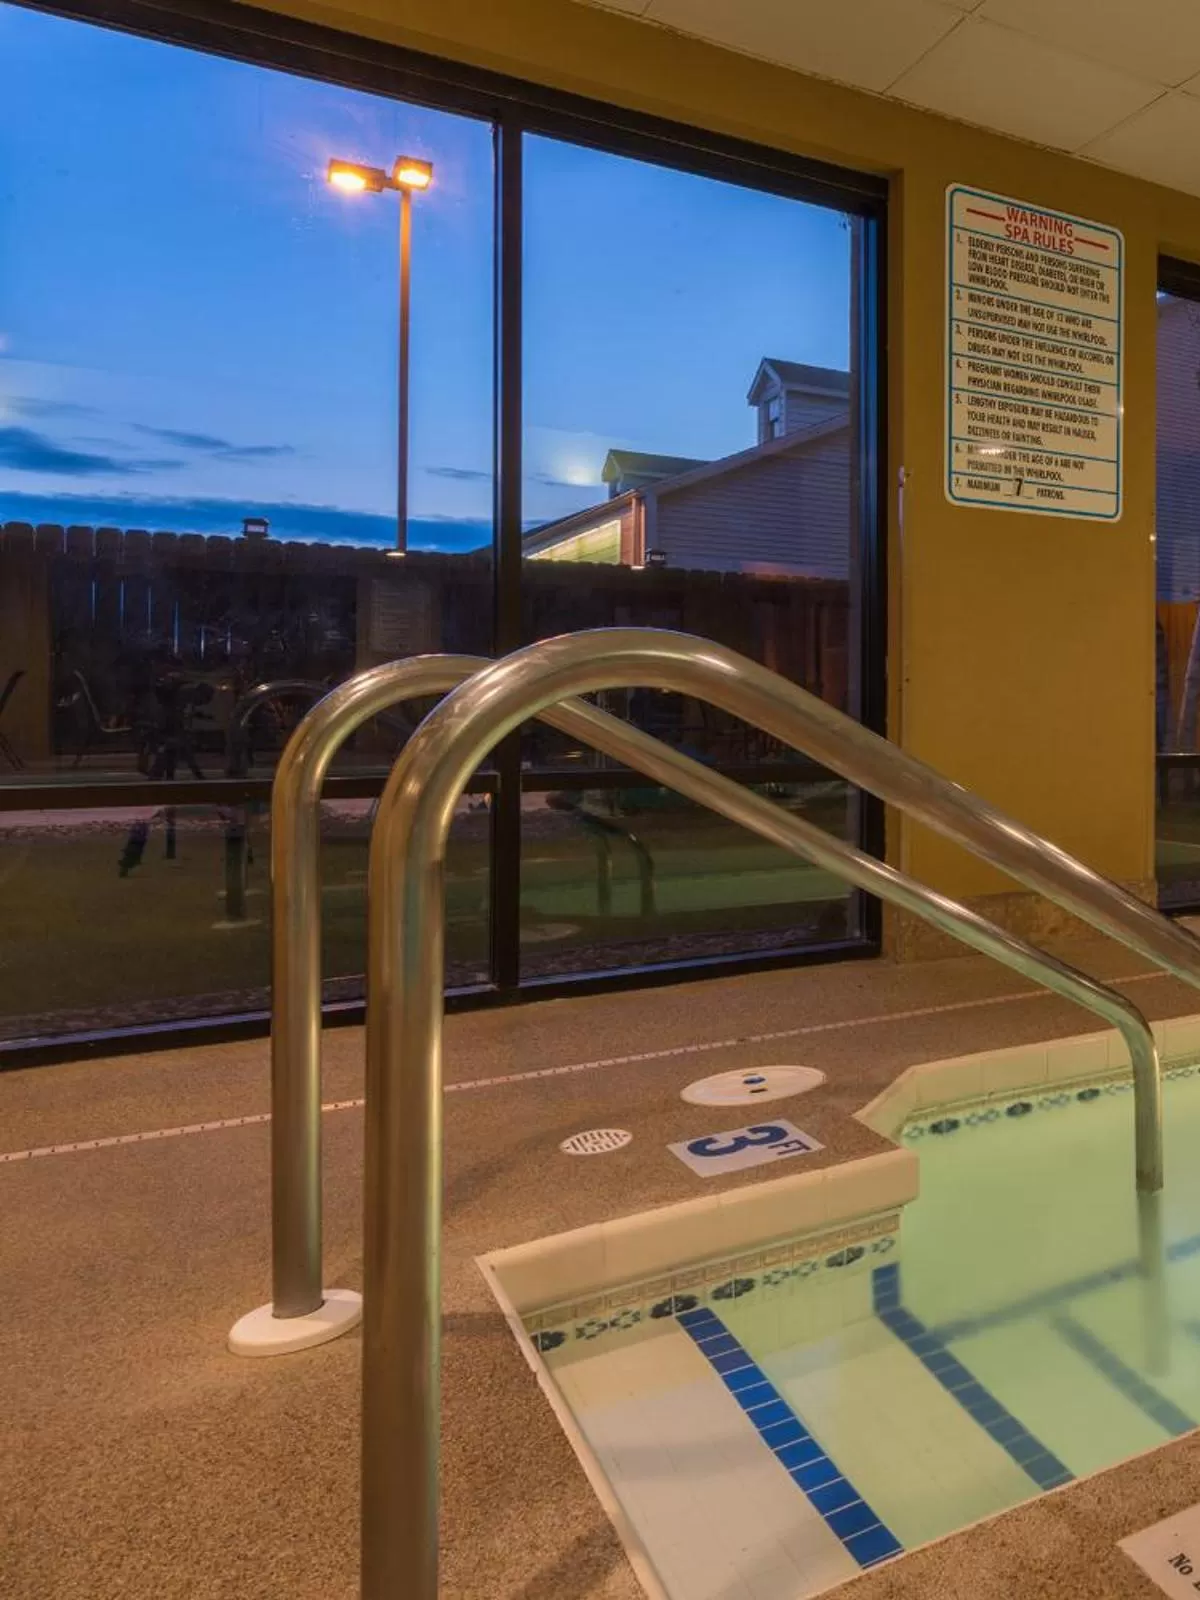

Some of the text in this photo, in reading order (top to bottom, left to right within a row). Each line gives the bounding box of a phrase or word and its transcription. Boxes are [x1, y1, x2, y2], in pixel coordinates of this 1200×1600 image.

[1006, 207, 1073, 237] WARNING
[1004, 224, 1075, 255] SPA RULES
[967, 236, 994, 252] ELDERLY
[995, 243, 1024, 259] PERSONS
[1025, 250, 1038, 263] AND
[1040, 254, 1067, 270] PERSONS
[1068, 261, 1100, 278] SUFFERING
[967, 248, 987, 262] FROM
[988, 254, 1009, 267] HEART
[1079, 276, 1094, 288] HIGH
[967, 260, 1110, 303] LOW BLOOD PRESSURE SHOULD NOT ENTER THE
[967, 292, 994, 307] MINORS
[995, 298, 1017, 312] UNDER
[1019, 303, 1031, 315] THE
[1032, 306, 1044, 318] AGE
[1065, 313, 1079, 325] WHO
[1081, 317, 1092, 328] ARE
[967, 307, 1016, 326] UNSUPERVISED
[1017, 317, 1031, 329] MAY
[1032, 320, 1044, 332] NOT
[1045, 323, 1057, 335] USE
[1058, 326, 1070, 337] THE
[967, 326, 997, 342] PERSONS
[997, 332, 1020, 346] UNDER
[1021, 337, 1034, 349] THE
[1034, 340, 1067, 356] INFLUENCE
[967, 341, 990, 355] DRUGS
[991, 346, 1005, 358] MAY
[1006, 349, 1020, 360] NOT
[1021, 352, 1032, 363] USE
[1034, 354, 1046, 365] THE
[967, 361, 1002, 376] PREGNANT
[1003, 367, 1028, 381] WOMEN
[1030, 372, 1054, 386] SHOULD
[1056, 377, 1082, 391] CONSULT
[1083, 382, 1100, 394] THEIR
[967, 376, 1001, 391] PHYSICIAN
[1002, 382, 1039, 398] REGARDING
[1040, 389, 1076, 404] WHIRLPOOL
[967, 395, 996, 409] LENGTHY
[997, 400, 1029, 415] EXPOSURE
[1031, 406, 1043, 417] MAY
[1053, 409, 1089, 424] HAZARDOUS
[967, 410, 985, 422] YOUR
[986, 413, 1010, 426] HEALTH
[1012, 417, 1026, 428] AND
[1027, 419, 1040, 431] MAY
[1041, 422, 1062, 434] RESULT
[967, 425, 1000, 439] DIZZINESS
[1012, 432, 1043, 445] FAINTING.
[967, 459, 1001, 473] PERMITTED
[1012, 465, 1024, 476] THE
[1026, 467, 1064, 481] WHIRLPOOL.
[995, 448, 1017, 460] DER
[1018, 451, 1030, 462] THE
[1031, 453, 1043, 464] AGE
[1059, 457, 1071, 468] ARE
[1071, 459, 1085, 470] NOT
[966, 479, 1000, 492] MAXIMUM
[1015, 477, 1023, 496] 7
[687, 1125, 811, 1157] 3 FT
[1168, 1552, 1193, 1575] No
